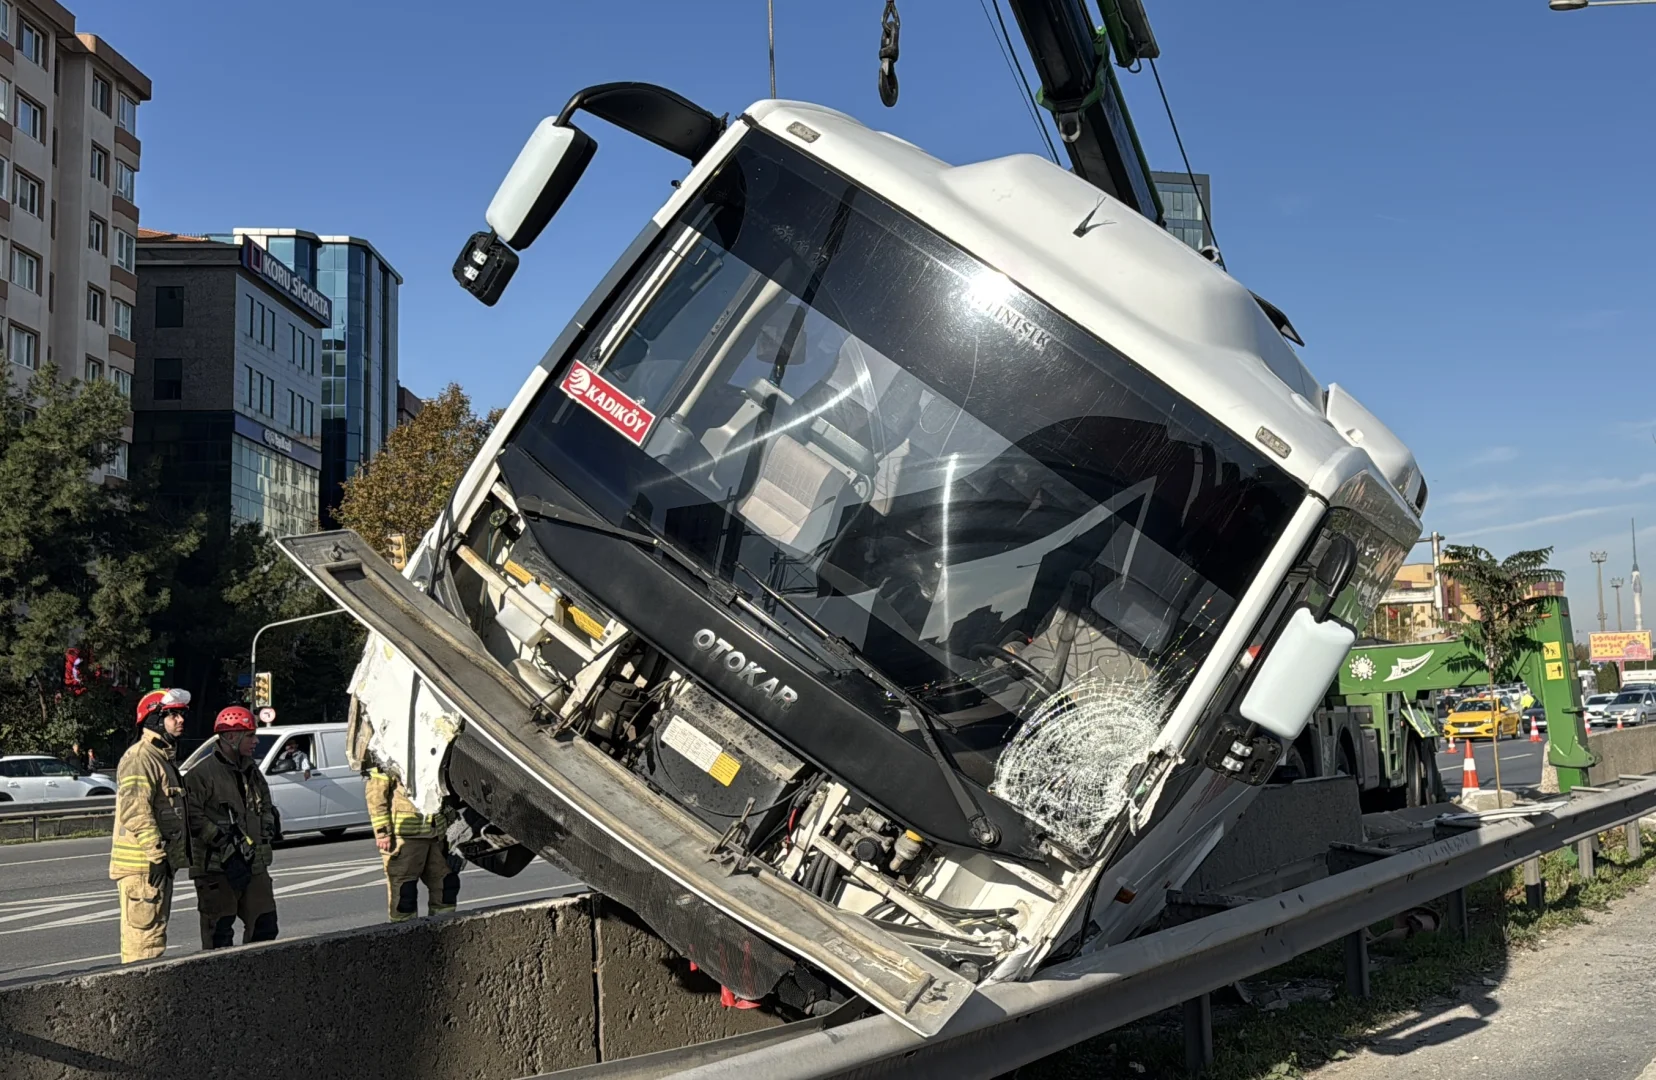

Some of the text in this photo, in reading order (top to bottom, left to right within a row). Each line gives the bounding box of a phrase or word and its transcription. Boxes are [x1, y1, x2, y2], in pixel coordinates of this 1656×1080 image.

[263, 254, 330, 320] KORU SİGORTA
[585, 384, 647, 433] KADIKÖY
[692, 628, 798, 713] OTOKAR
